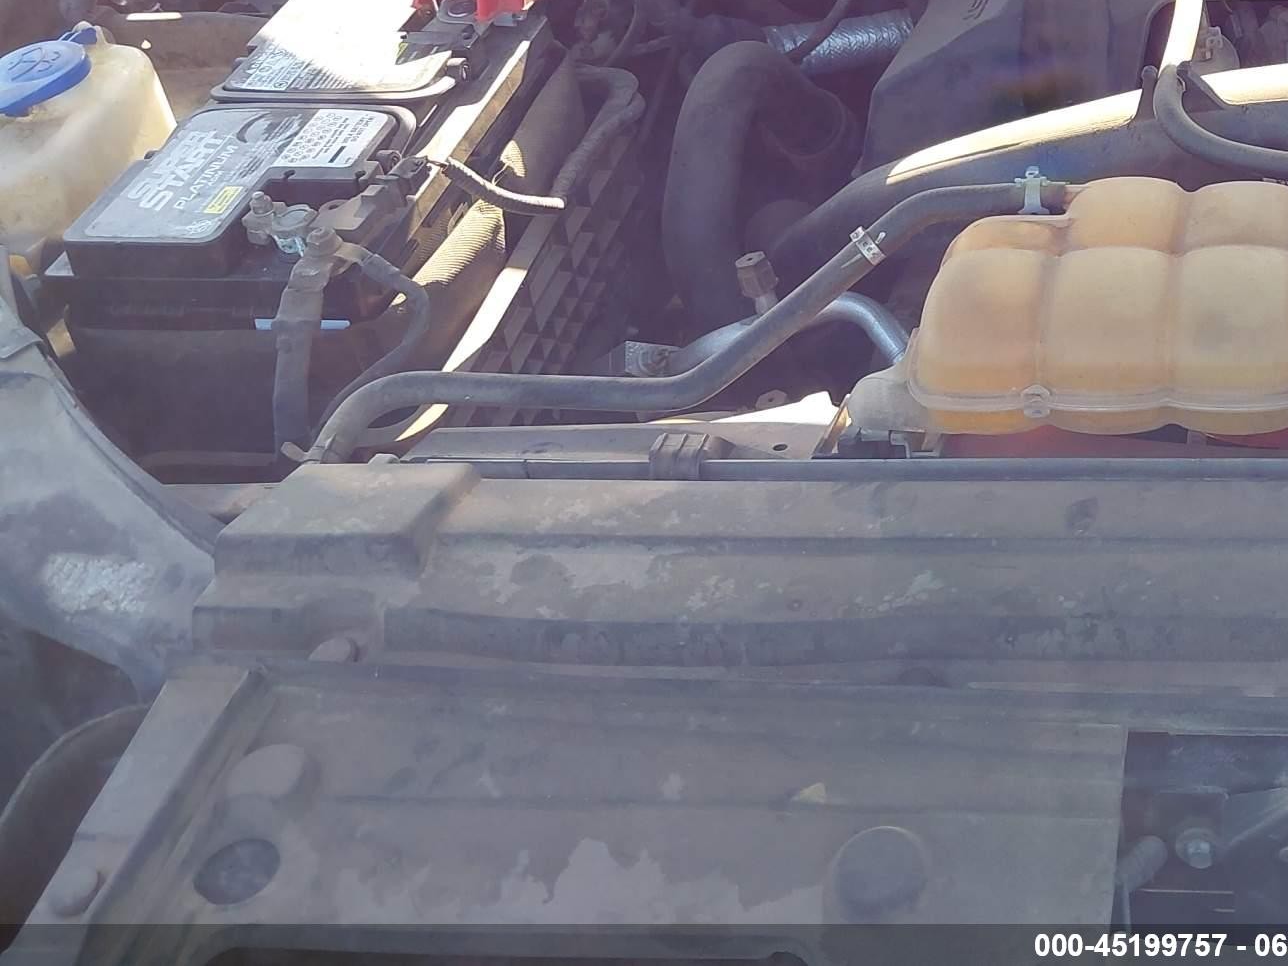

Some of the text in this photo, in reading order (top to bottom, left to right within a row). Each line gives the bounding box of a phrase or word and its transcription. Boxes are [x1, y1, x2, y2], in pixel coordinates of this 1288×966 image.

[127, 130, 207, 201] SUPER
[138, 130, 224, 211] START
[173, 144, 239, 210] PLATINUM
